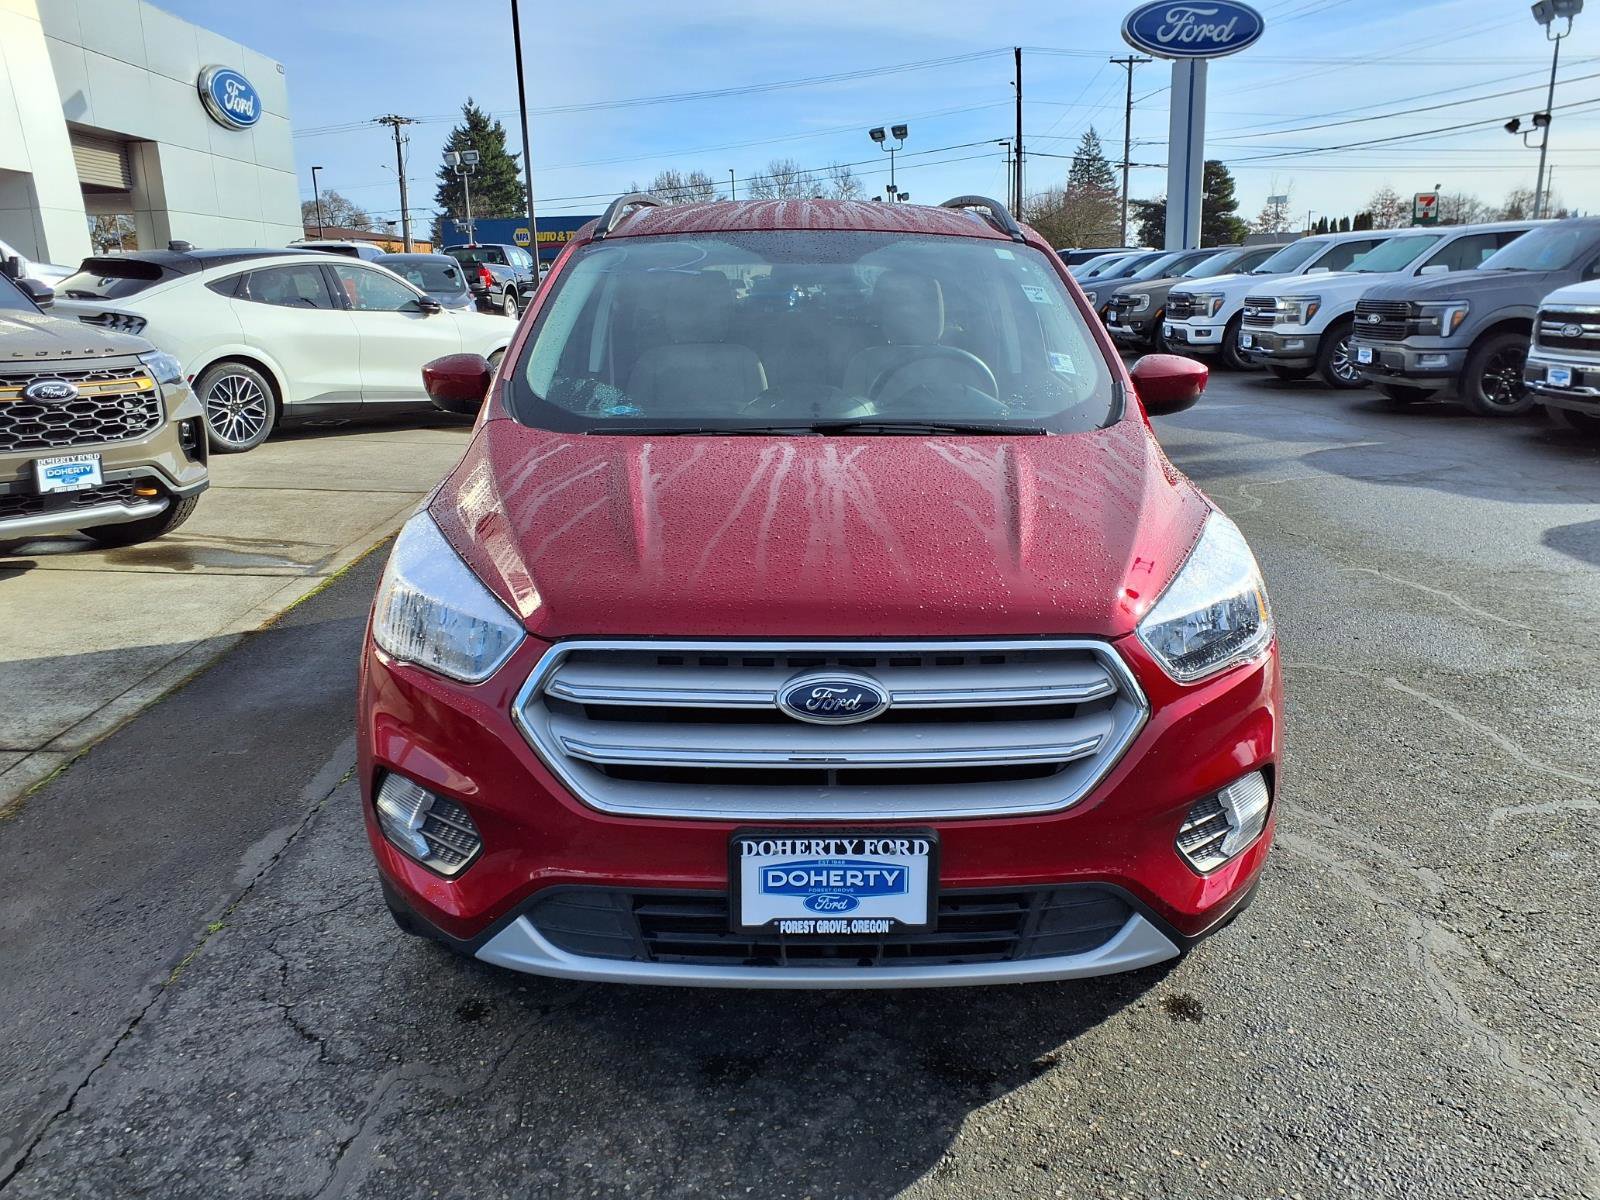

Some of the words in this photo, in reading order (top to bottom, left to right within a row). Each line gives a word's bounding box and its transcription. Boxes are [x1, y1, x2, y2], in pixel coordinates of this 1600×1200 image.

[1156, 7, 1239, 43] Ford
[223, 79, 255, 118] Ford
[1418, 195, 1436, 219] 7
[557, 231, 566, 241] &
[41, 386, 68, 397] Ford
[77, 453, 100, 461] FORD
[47, 466, 91, 477] DOHERTY
[806, 687, 862, 711] Ford
[740, 839, 859, 857] DOHERTY
[864, 839, 930, 857] FORD
[767, 870, 900, 887] DOHERTY
[814, 895, 848, 910] Ford
[780, 921, 815, 934] FOREST
[816, 921, 851, 935] GROVE,
[852, 920, 889, 934] OREGON
